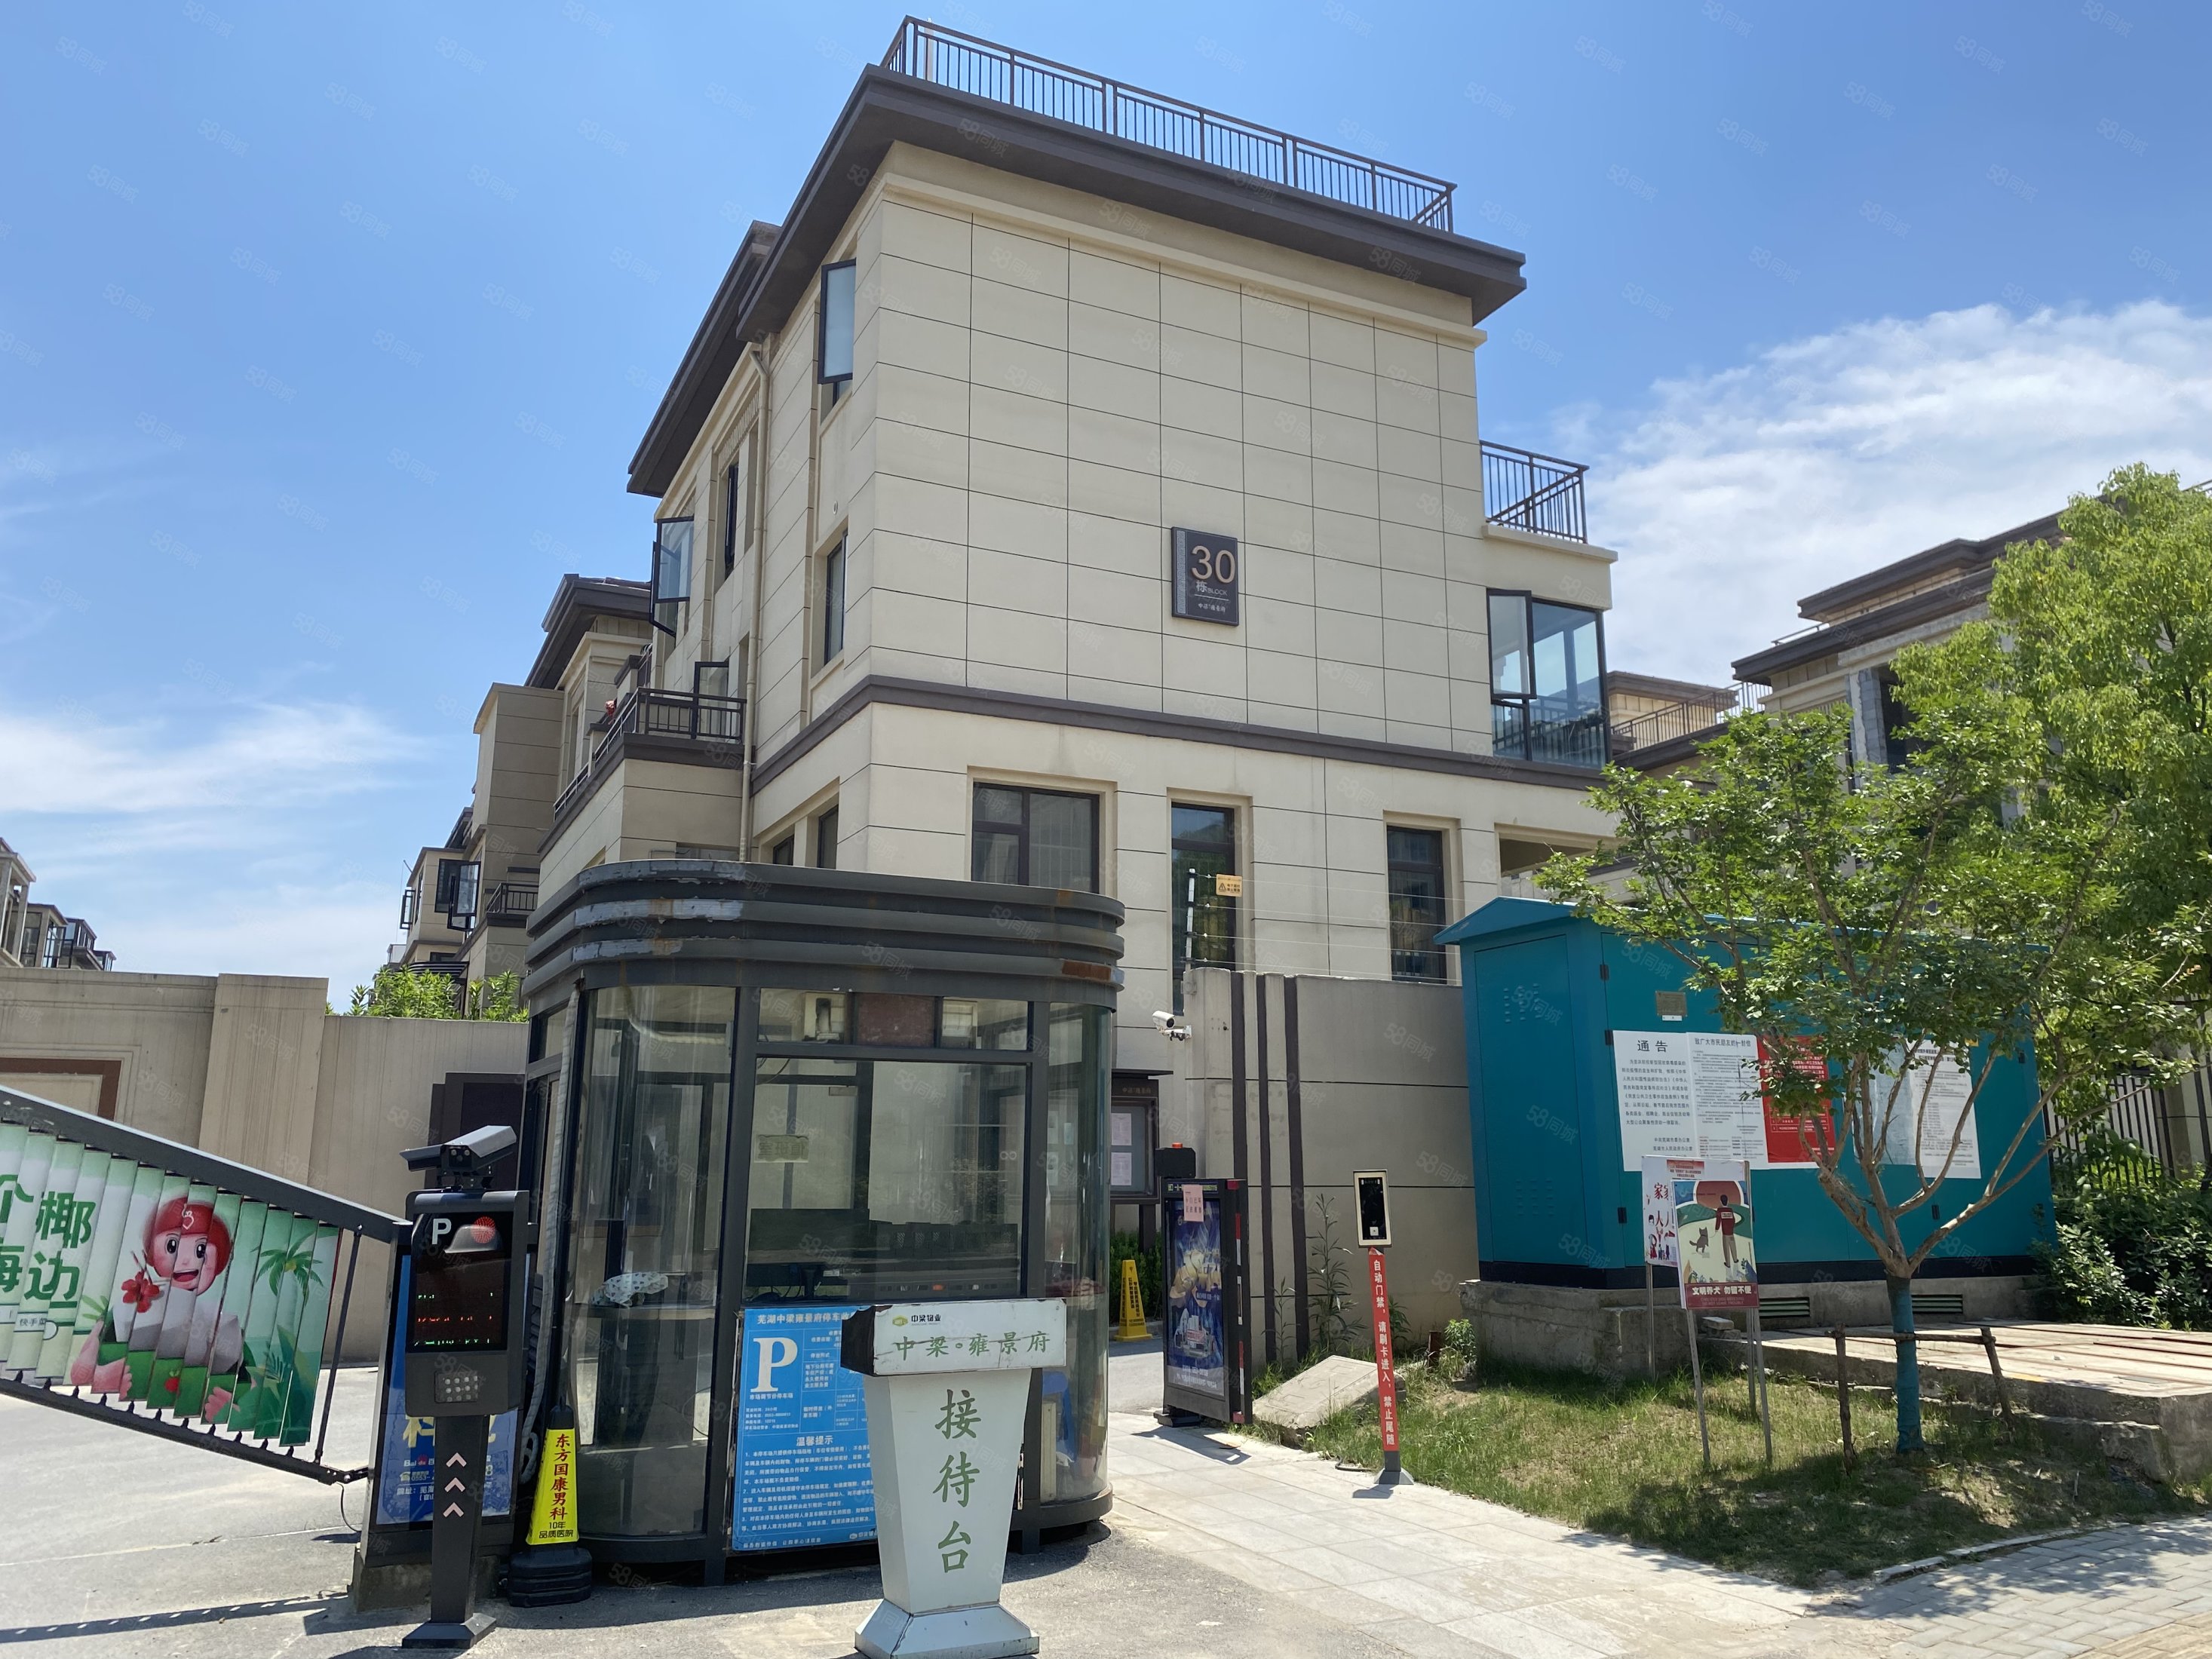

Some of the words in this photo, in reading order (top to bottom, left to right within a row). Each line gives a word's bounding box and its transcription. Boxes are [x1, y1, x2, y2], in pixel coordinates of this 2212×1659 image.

[1191, 545, 1236, 584] 30
[1195, 581, 1207, 593] 栋
[1207, 587, 1228, 596] BLOCK
[1637, 1040, 1668, 1053] 通告
[1694, 1038, 1751, 1047] 致广大市民朋友的一封信
[432, 1218, 452, 1245] P
[1692, 1286, 1720, 1296] 文明养犬
[911, 1314, 941, 1324] 中梁物业
[750, 1337, 798, 1393] P
[796, 1435, 833, 1446] 温馨提示
[550, 1433, 572, 1521] 东方国康男科
[932, 1388, 982, 1575] 接待台
[538, 1529, 574, 1539] 品质医院
